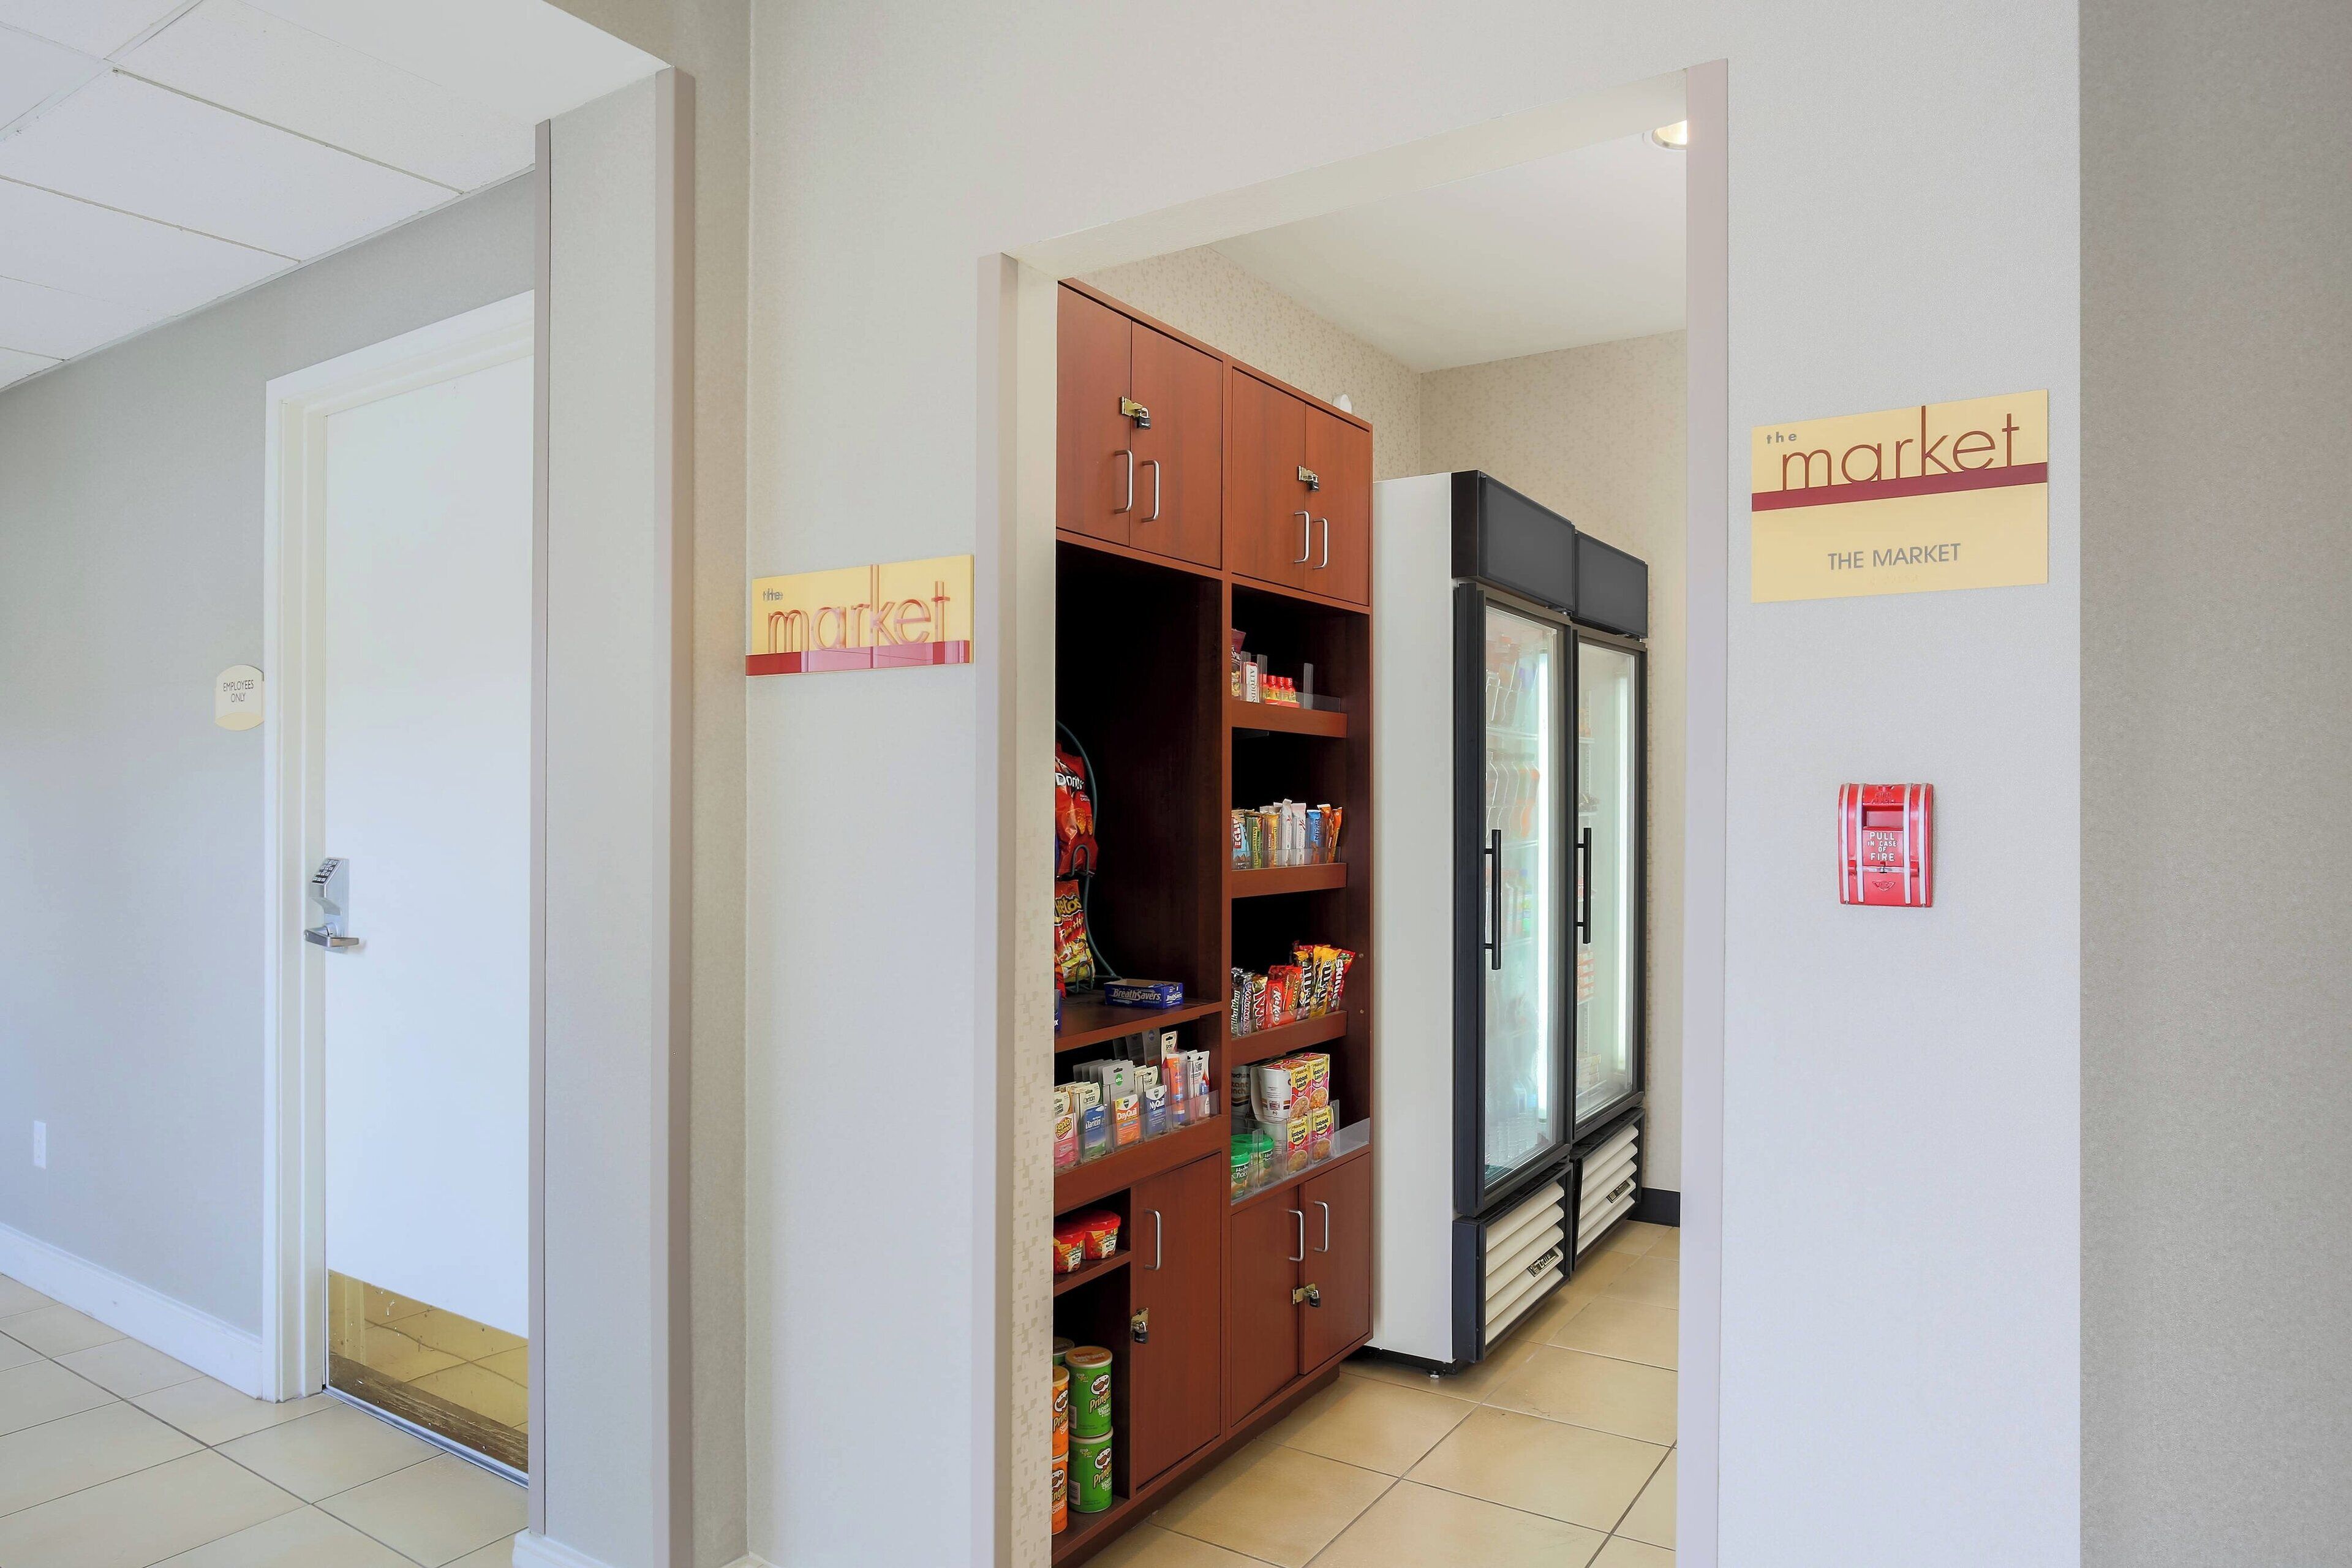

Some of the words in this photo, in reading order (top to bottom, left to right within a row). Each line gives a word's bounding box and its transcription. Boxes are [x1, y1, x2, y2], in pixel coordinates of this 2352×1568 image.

[1766, 431, 1798, 445] the
[1782, 405, 2020, 492] market
[1828, 551, 1864, 571] THE
[1872, 543, 1961, 567] MARKET
[767, 564, 951, 655] market
[223, 679, 254, 692] EMPLOYEES
[230, 693, 246, 703] ONLY
[1869, 832, 1895, 841] PULL
[1871, 853, 1895, 862] FIRE
